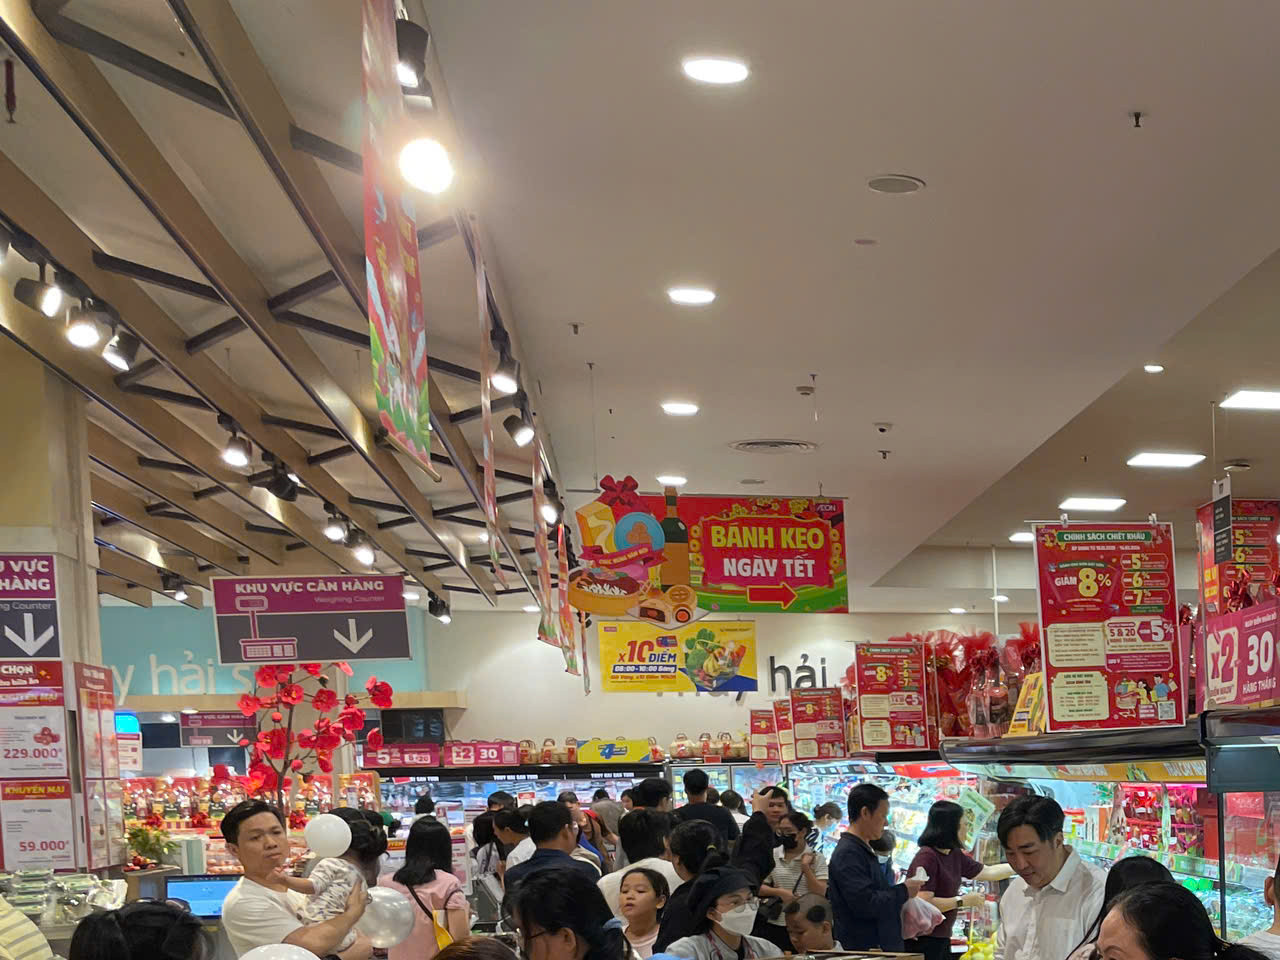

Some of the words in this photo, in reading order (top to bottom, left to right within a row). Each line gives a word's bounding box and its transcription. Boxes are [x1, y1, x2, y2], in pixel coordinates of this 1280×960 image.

[711, 522, 775, 549] BÁNH
[9, 558, 50, 576] VỰC
[722, 554, 778, 578] NGÀY
[782, 553, 815, 578] TẾT
[0, 575, 51, 591] HÀNG
[235, 583, 268, 593] KHU
[270, 581, 304, 595] VỰC
[306, 579, 338, 592] CÂN
[342, 578, 385, 591] HÀNG
[12, 601, 52, 610] Counter
[1247, 630, 1274, 676] 30
[149, 649, 216, 695] hải
[768, 653, 827, 692] hải
